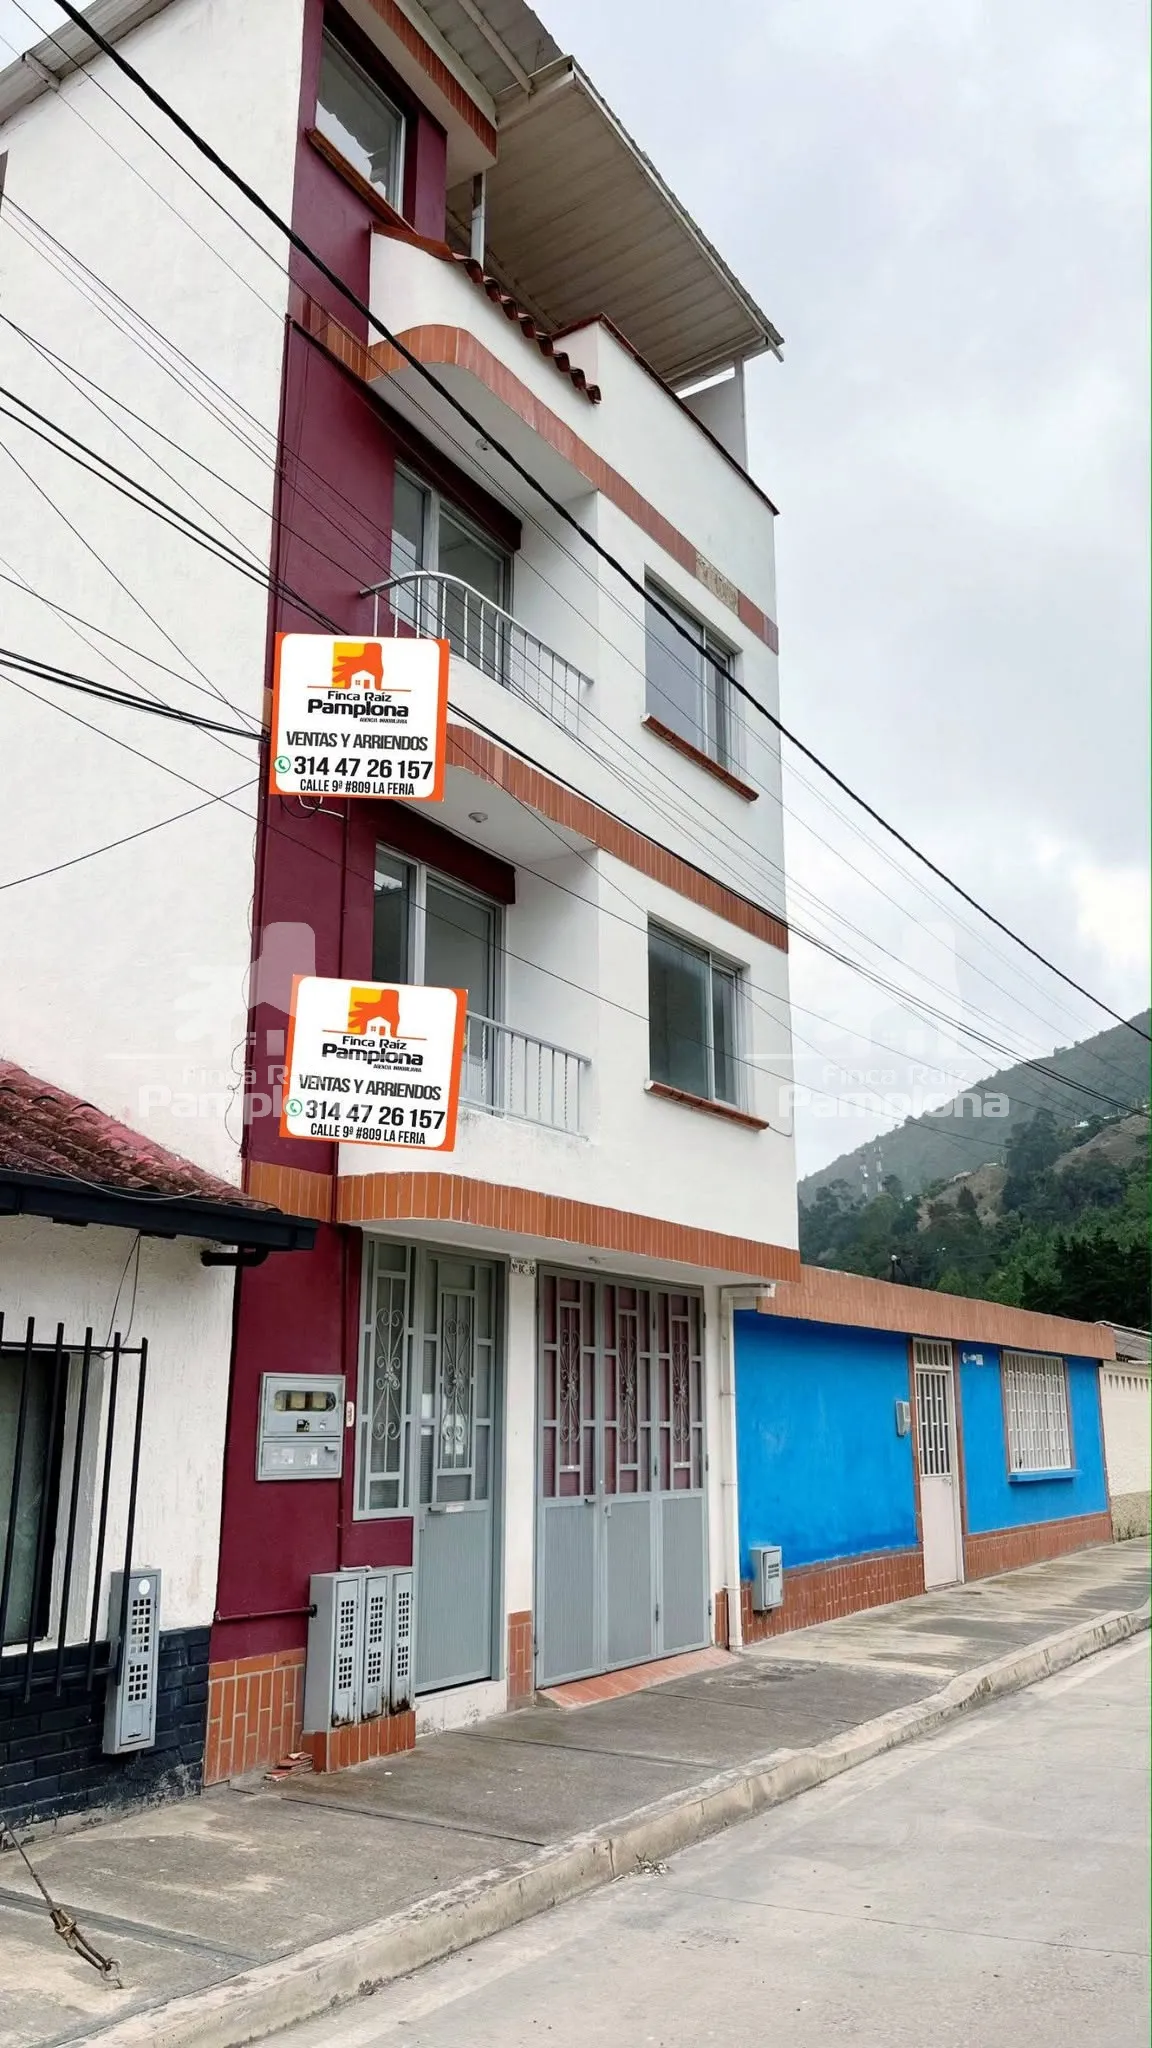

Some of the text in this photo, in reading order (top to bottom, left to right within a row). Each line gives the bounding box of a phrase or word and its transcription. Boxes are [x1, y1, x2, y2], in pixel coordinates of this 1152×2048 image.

[327, 690, 392, 702] Finca Raíz
[307, 698, 409, 718] Pamplona
[286, 731, 429, 751] VENTAS Y ARRIENDOS
[294, 756, 433, 780] 314 47 26 157
[300, 779, 329, 793] CALLE
[344, 781, 371, 794] #809
[373, 782, 386, 794] LA
[387, 783, 415, 795] FERIA
[342, 1035, 407, 1050] Finca Raíz
[321, 1043, 424, 1066] Pamplona
[299, 1074, 351, 1094] VENTAS
[353, 1079, 364, 1094] Y
[365, 1081, 442, 1101] ARRIENDOS
[305, 1099, 446, 1130] 314 47 26 157
[310, 1122, 341, 1137] CALLE
[355, 1127, 382, 1141] #809
[384, 1130, 396, 1142] LA
[398, 1131, 426, 1145] FERIA
